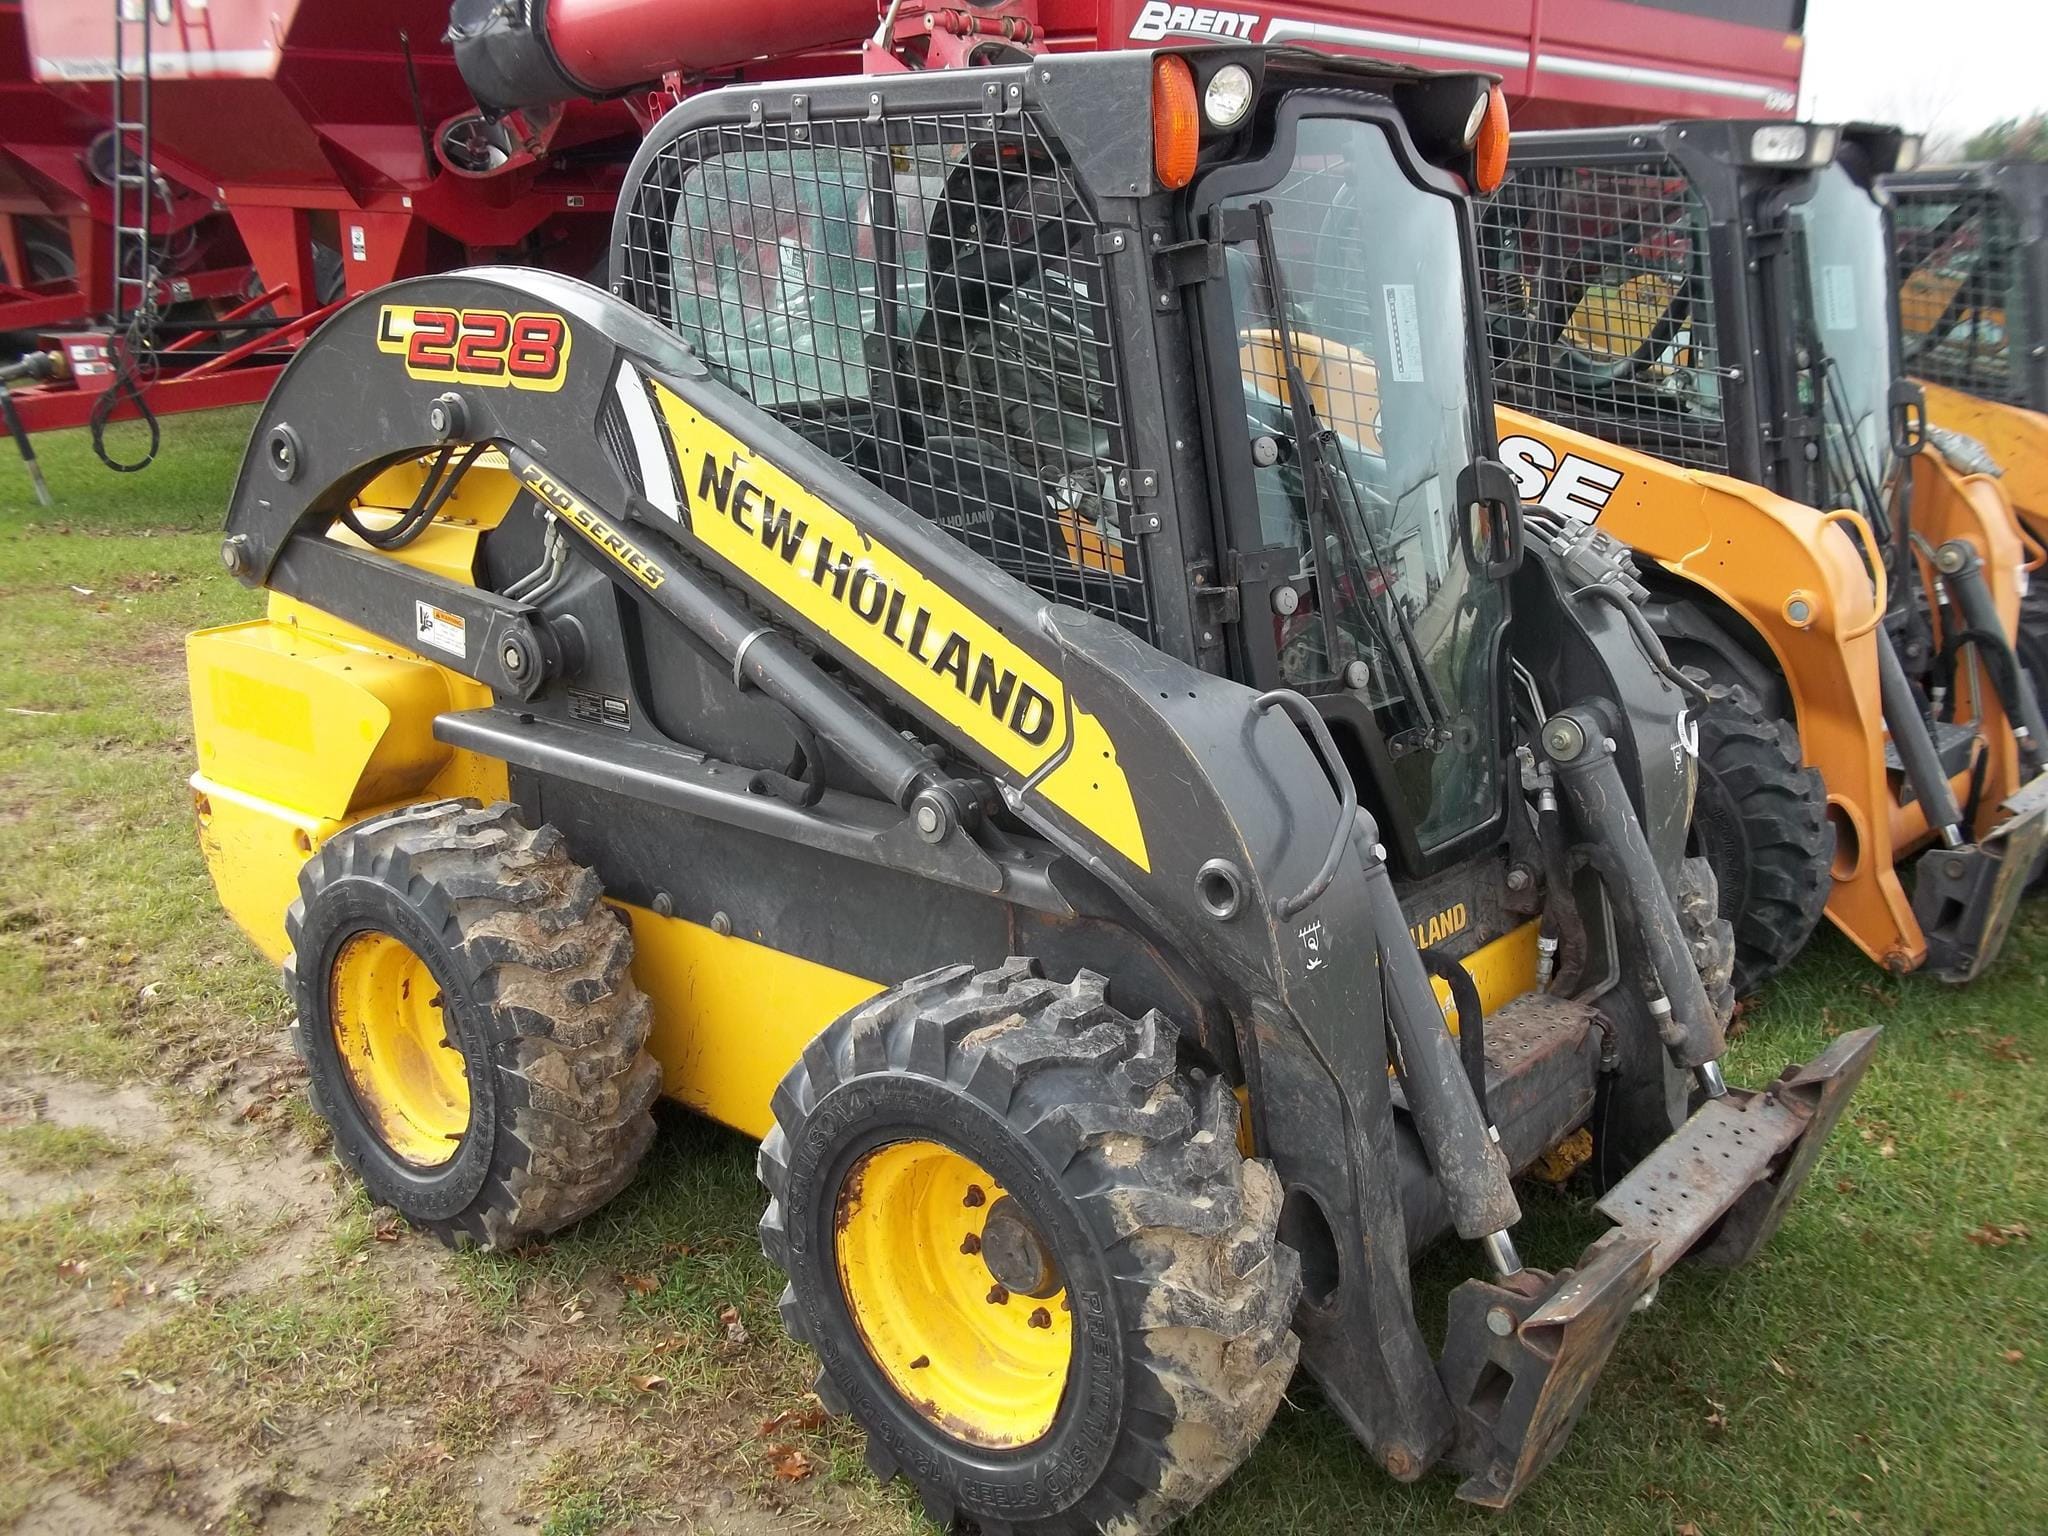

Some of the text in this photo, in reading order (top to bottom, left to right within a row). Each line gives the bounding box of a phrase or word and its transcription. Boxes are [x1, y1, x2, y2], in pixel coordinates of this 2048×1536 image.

[1129, 2, 1260, 41] BRENT
[380, 309, 566, 378] L228
[1499, 435, 1624, 525] SE
[525, 469, 664, 585] 200 SERIES
[946, 510, 995, 527] HOLAND
[698, 452, 1055, 746] NEW HOLLAND
[963, 1476, 1041, 1509] STEER
